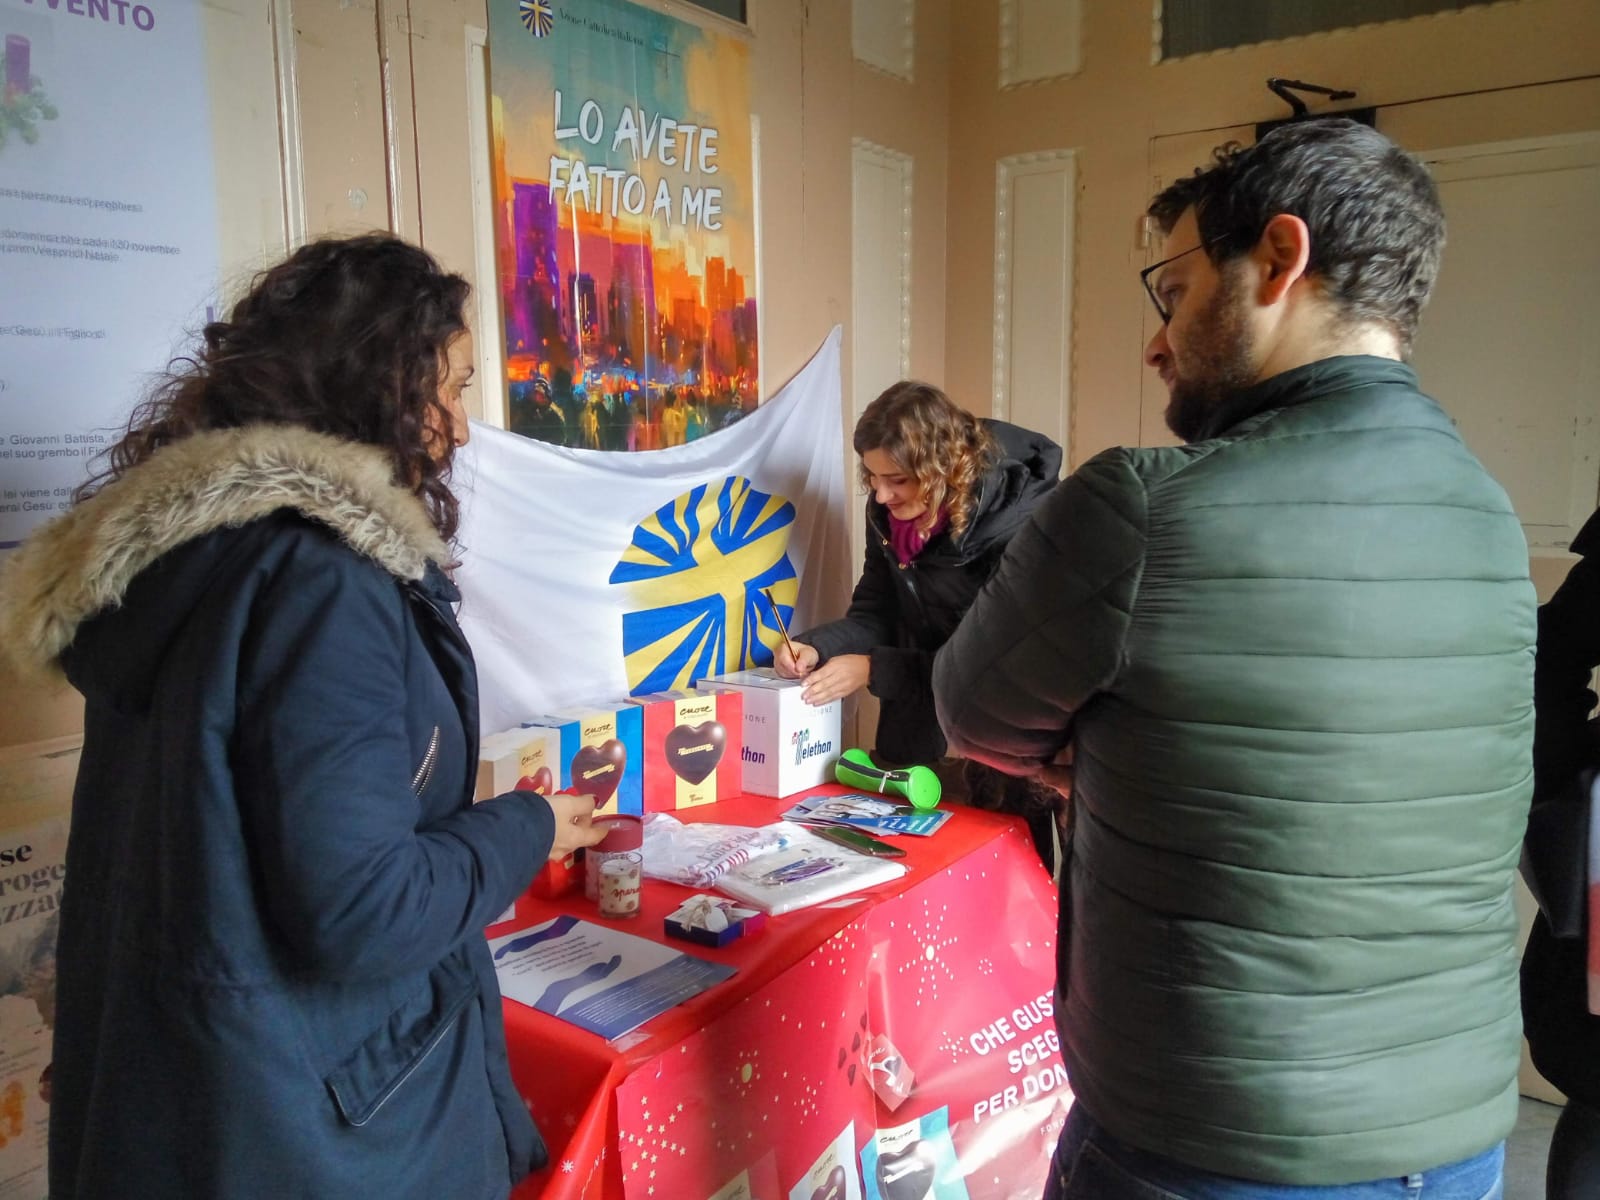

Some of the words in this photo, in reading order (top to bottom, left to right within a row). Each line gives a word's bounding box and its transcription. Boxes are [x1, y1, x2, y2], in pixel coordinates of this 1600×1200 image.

[554, 89, 604, 144] LO
[612, 106, 719, 174] AVETE
[548, 155, 646, 218] FATTO
[651, 178, 671, 228] A
[681, 186, 722, 232] ME
[10, 434, 60, 445] Giovanni
[15, 450, 36, 458] suo
[38, 447, 80, 460] grembo
[20, 487, 50, 498] viene
[741, 745, 765, 764] thon
[0, 845, 32, 867] se
[969, 1017, 1017, 1056] CHE
[1007, 1029, 1060, 1074] SCEG
[973, 1085, 1019, 1124] PER
